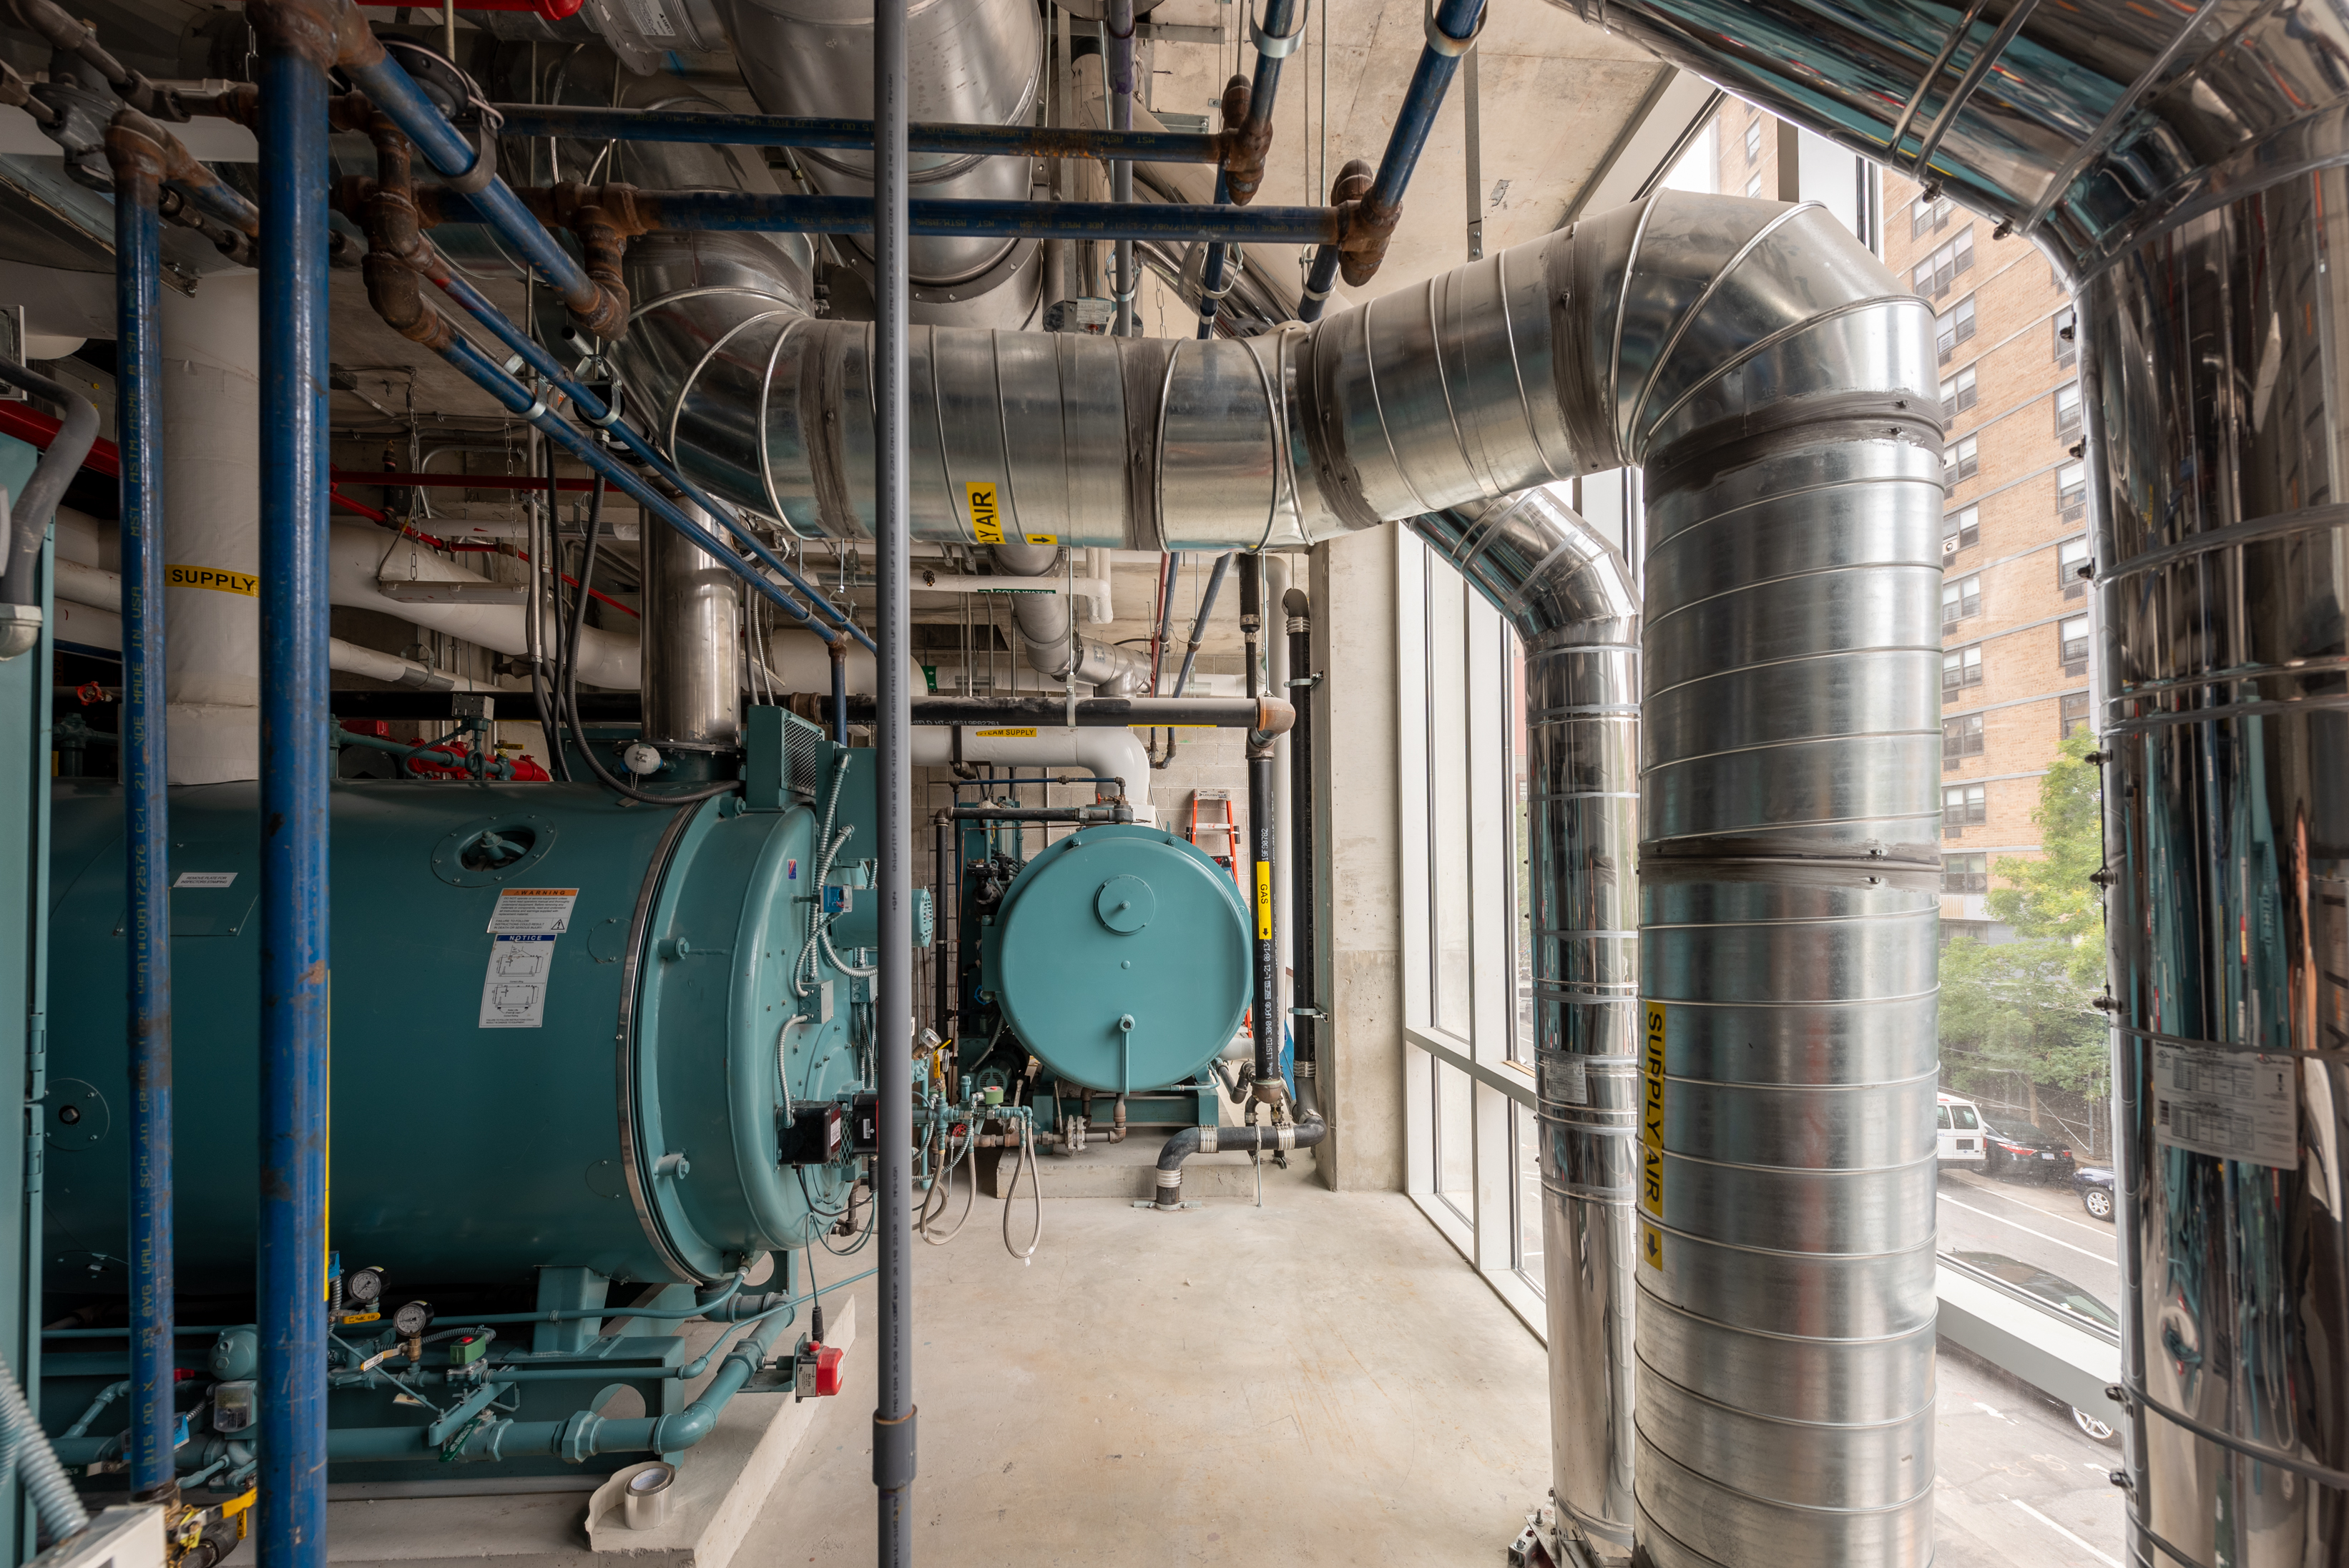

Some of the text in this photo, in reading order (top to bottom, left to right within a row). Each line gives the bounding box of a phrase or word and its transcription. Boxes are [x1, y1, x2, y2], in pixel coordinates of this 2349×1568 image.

[916, 218, 966, 227] ASTM/ASME
[127, 332, 137, 376] A/SA
[127, 385, 139, 484] ASTM/ASME
[130, 504, 140, 536] MST
[972, 491, 996, 527] AIR
[172, 569, 256, 592] SUPPLY
[132, 586, 142, 619] USA
[132, 629, 142, 648] IN
[134, 661, 144, 704] MADE
[134, 716, 144, 747] NDE
[891, 791, 897, 800] 80
[139, 1059, 149, 1113] GRADE
[1646, 1011, 1662, 1202] SUPPLY AIR
[139, 1123, 149, 1145] 40
[139, 1155, 150, 1188] SCH
[141, 1232, 152, 1275] WALL
[142, 1285, 152, 1318] AVG
